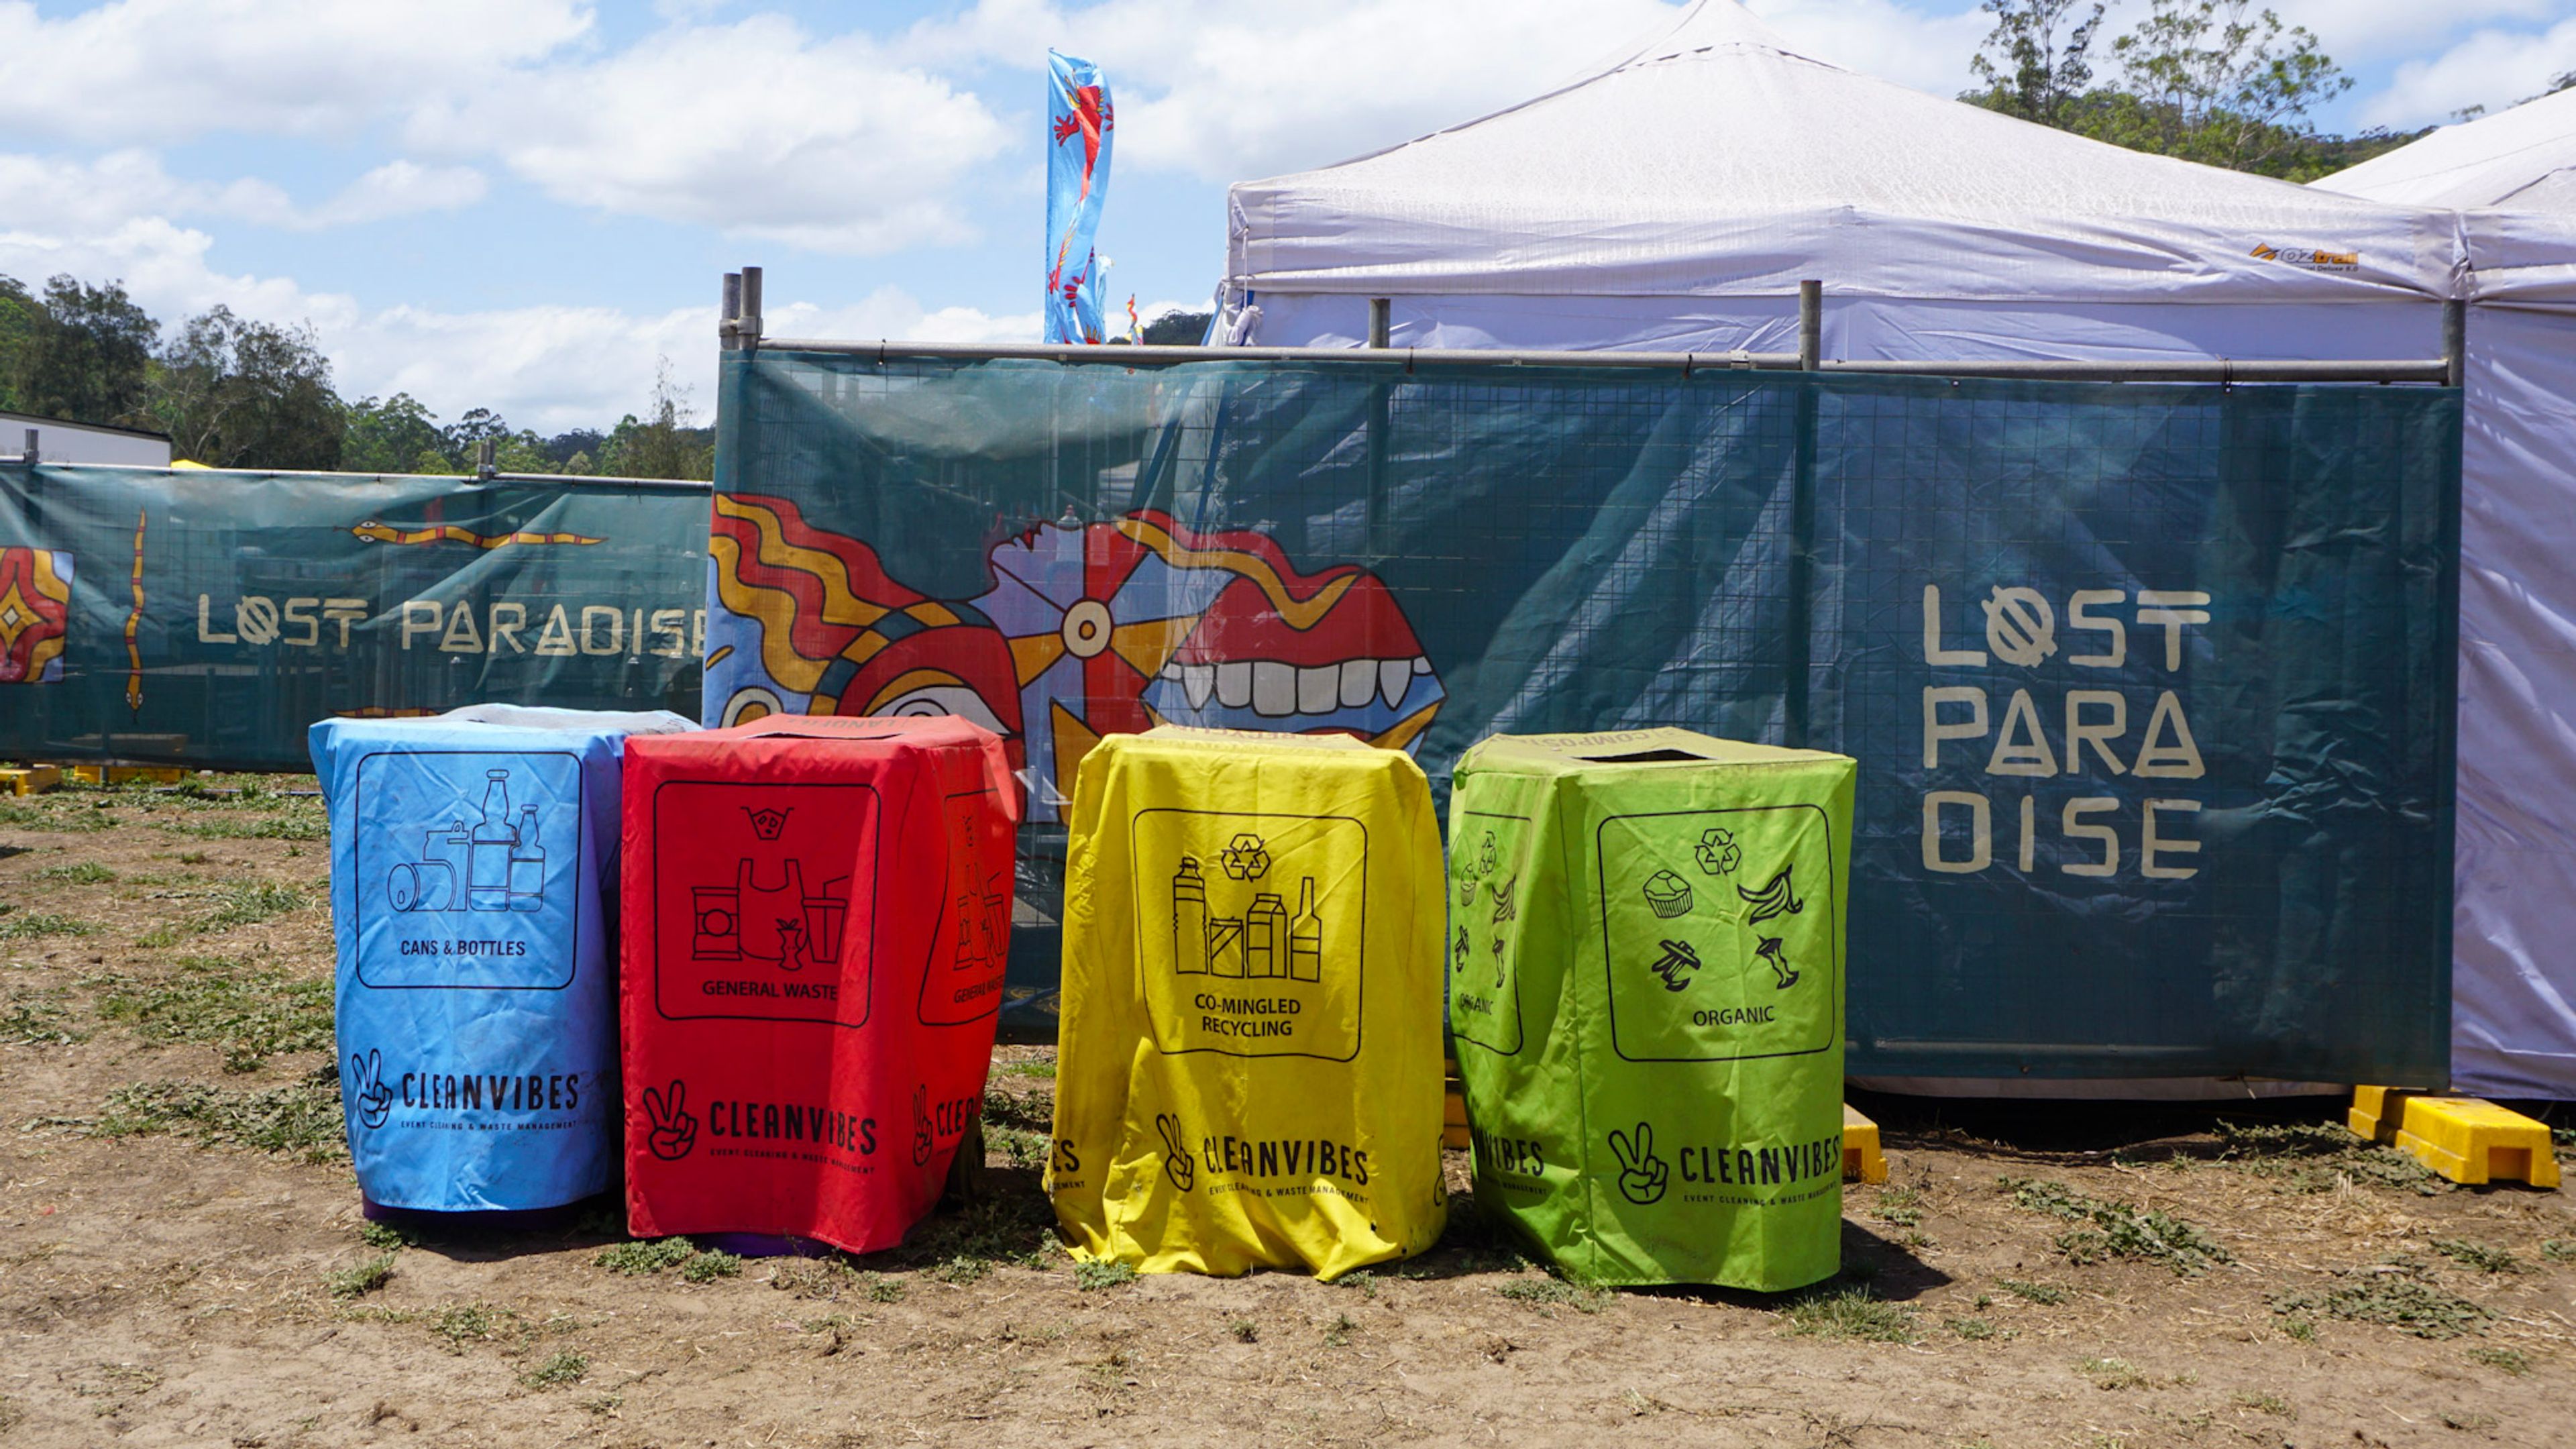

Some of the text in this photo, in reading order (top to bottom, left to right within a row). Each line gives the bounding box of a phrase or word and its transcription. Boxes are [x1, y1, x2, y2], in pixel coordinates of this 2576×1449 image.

[1923, 685, 2206, 780] PARA
[400, 941, 526, 956] CANS & BOTTLES
[702, 980, 838, 1001] GENERAL WASTE
[1195, 994, 1301, 1015] CO-MINGLED
[1202, 1016, 1292, 1037] RECYCLING
[1693, 1005, 1776, 1027] ORGANIC
[402, 1072, 580, 1110] CLEANVIBES
[400, 1120, 427, 1129] EVENT
[480, 1122, 513, 1130] WASTE
[710, 1101, 877, 1156] CLEANVIBES
[1203, 1136, 1368, 1187] CLEANVIBES
[1680, 1134, 1839, 1185] CLEANVIBES
[1277, 1184, 1307, 1197] WASTE
[1684, 1195, 1715, 1203] EVENT
[1719, 1196, 1766, 1207] CLEANING
